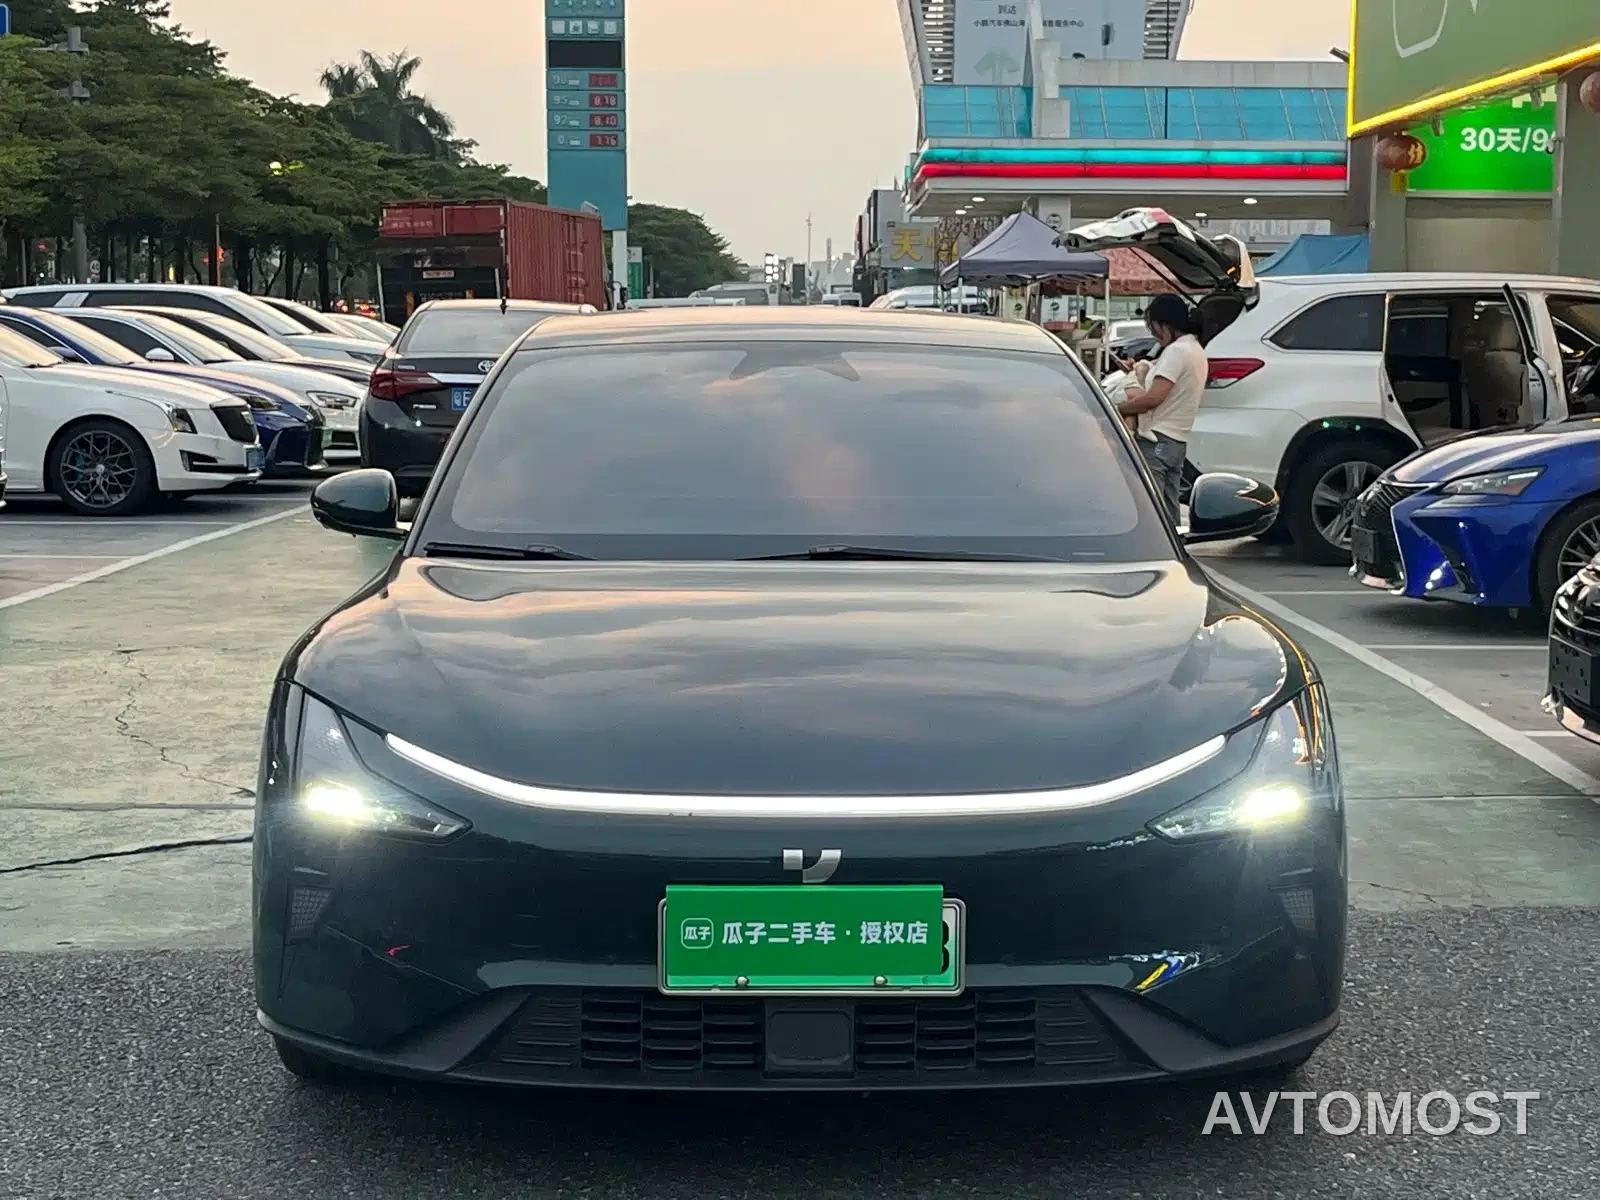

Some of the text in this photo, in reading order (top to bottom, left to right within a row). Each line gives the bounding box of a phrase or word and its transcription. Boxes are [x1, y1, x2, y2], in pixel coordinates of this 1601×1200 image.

[553, 114, 568, 125] 92
[1460, 127, 1556, 154] 30天/9
[684, 927, 711, 941] 瓜子
